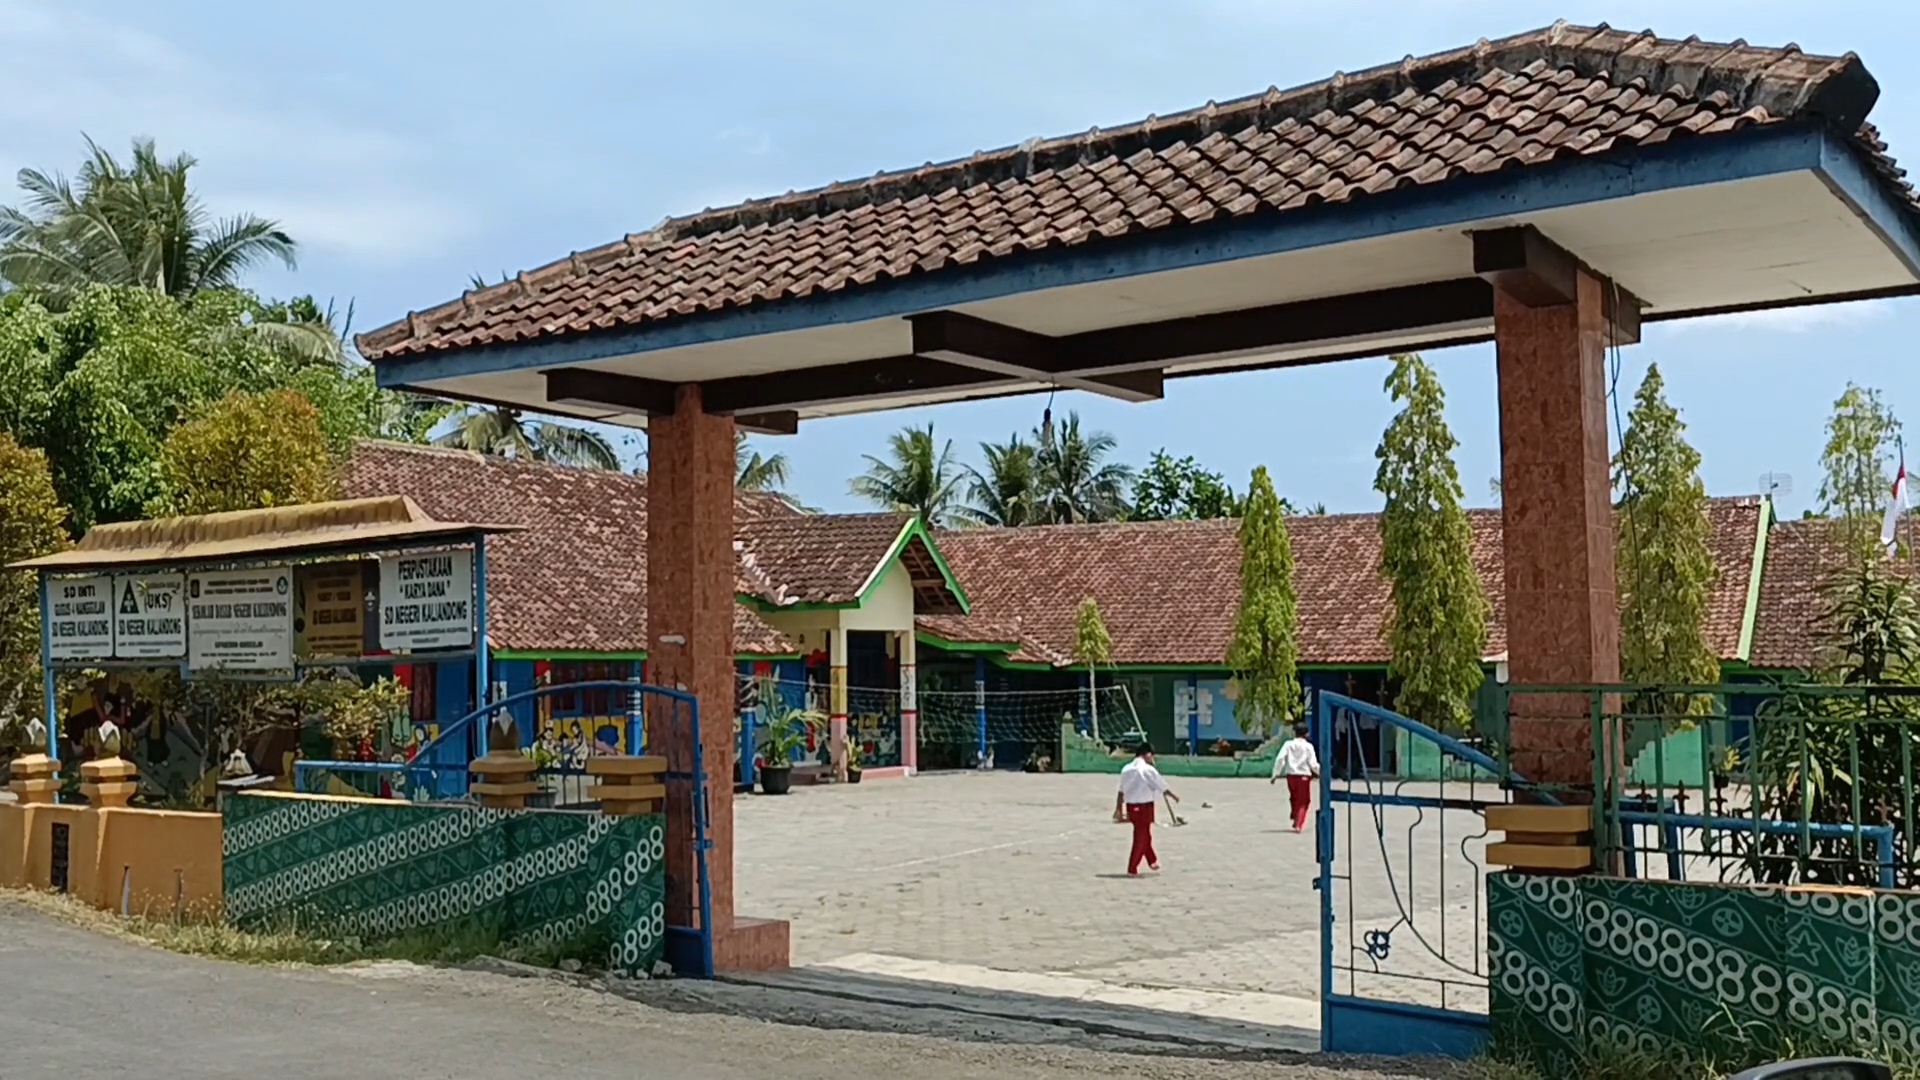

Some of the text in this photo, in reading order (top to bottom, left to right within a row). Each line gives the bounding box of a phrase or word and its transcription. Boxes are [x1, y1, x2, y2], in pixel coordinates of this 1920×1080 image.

[64, 586, 76, 598] SD
[384, 606, 394, 624] SD
[395, 605, 420, 624] NEGERI
